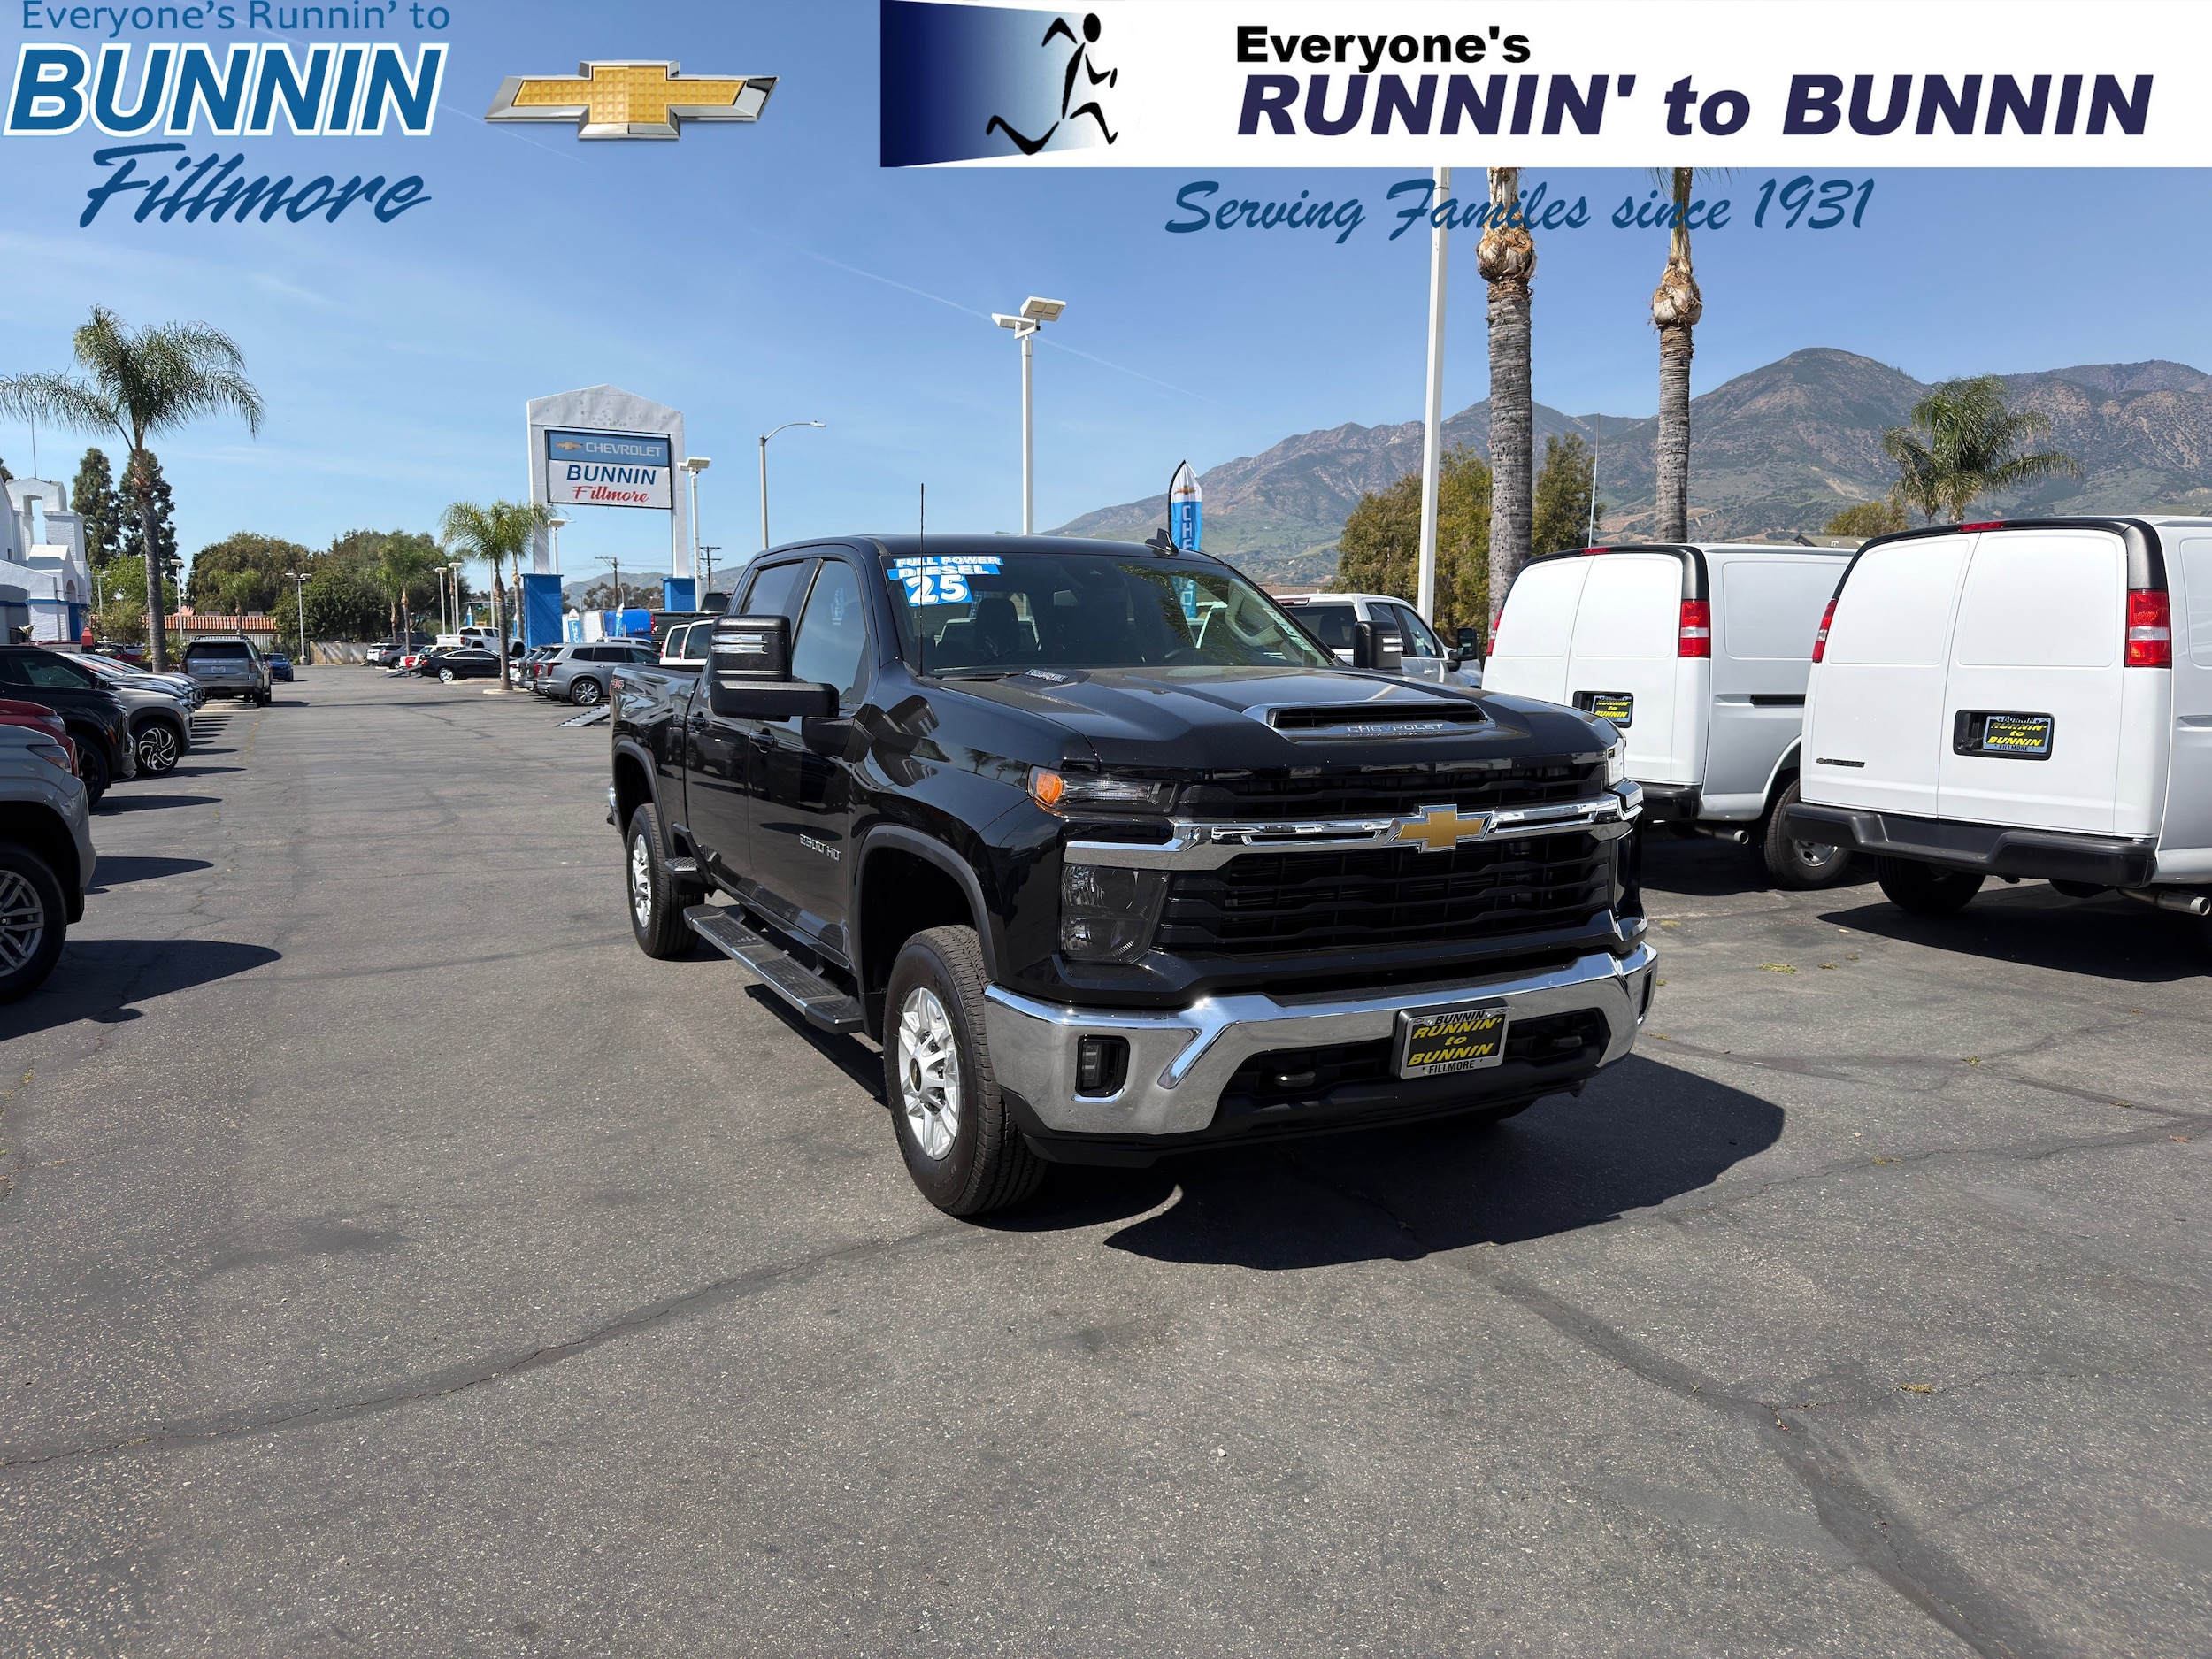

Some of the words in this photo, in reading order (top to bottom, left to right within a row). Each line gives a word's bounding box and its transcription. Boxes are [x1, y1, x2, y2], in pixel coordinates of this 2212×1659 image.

[585, 442, 662, 457] CHEVROLET
[566, 464, 657, 486] BUNNIN
[571, 485, 649, 503] Fillmore
[896, 557, 939, 567] FULL
[941, 555, 1001, 565] POWER
[898, 565, 989, 578] DIESEL
[905, 574, 967, 606] 25
[1987, 736, 2043, 747] BUNNIN
[826, 845, 841, 862] HD
[1434, 1010, 1486, 1025] BUNNIN
[1411, 1017, 1504, 1040] RUNNIN'
[1444, 1036, 1468, 1046] to
[1407, 1042, 1494, 1066] BUNNIN
[1428, 1060, 1475, 1075] FILLMORE
